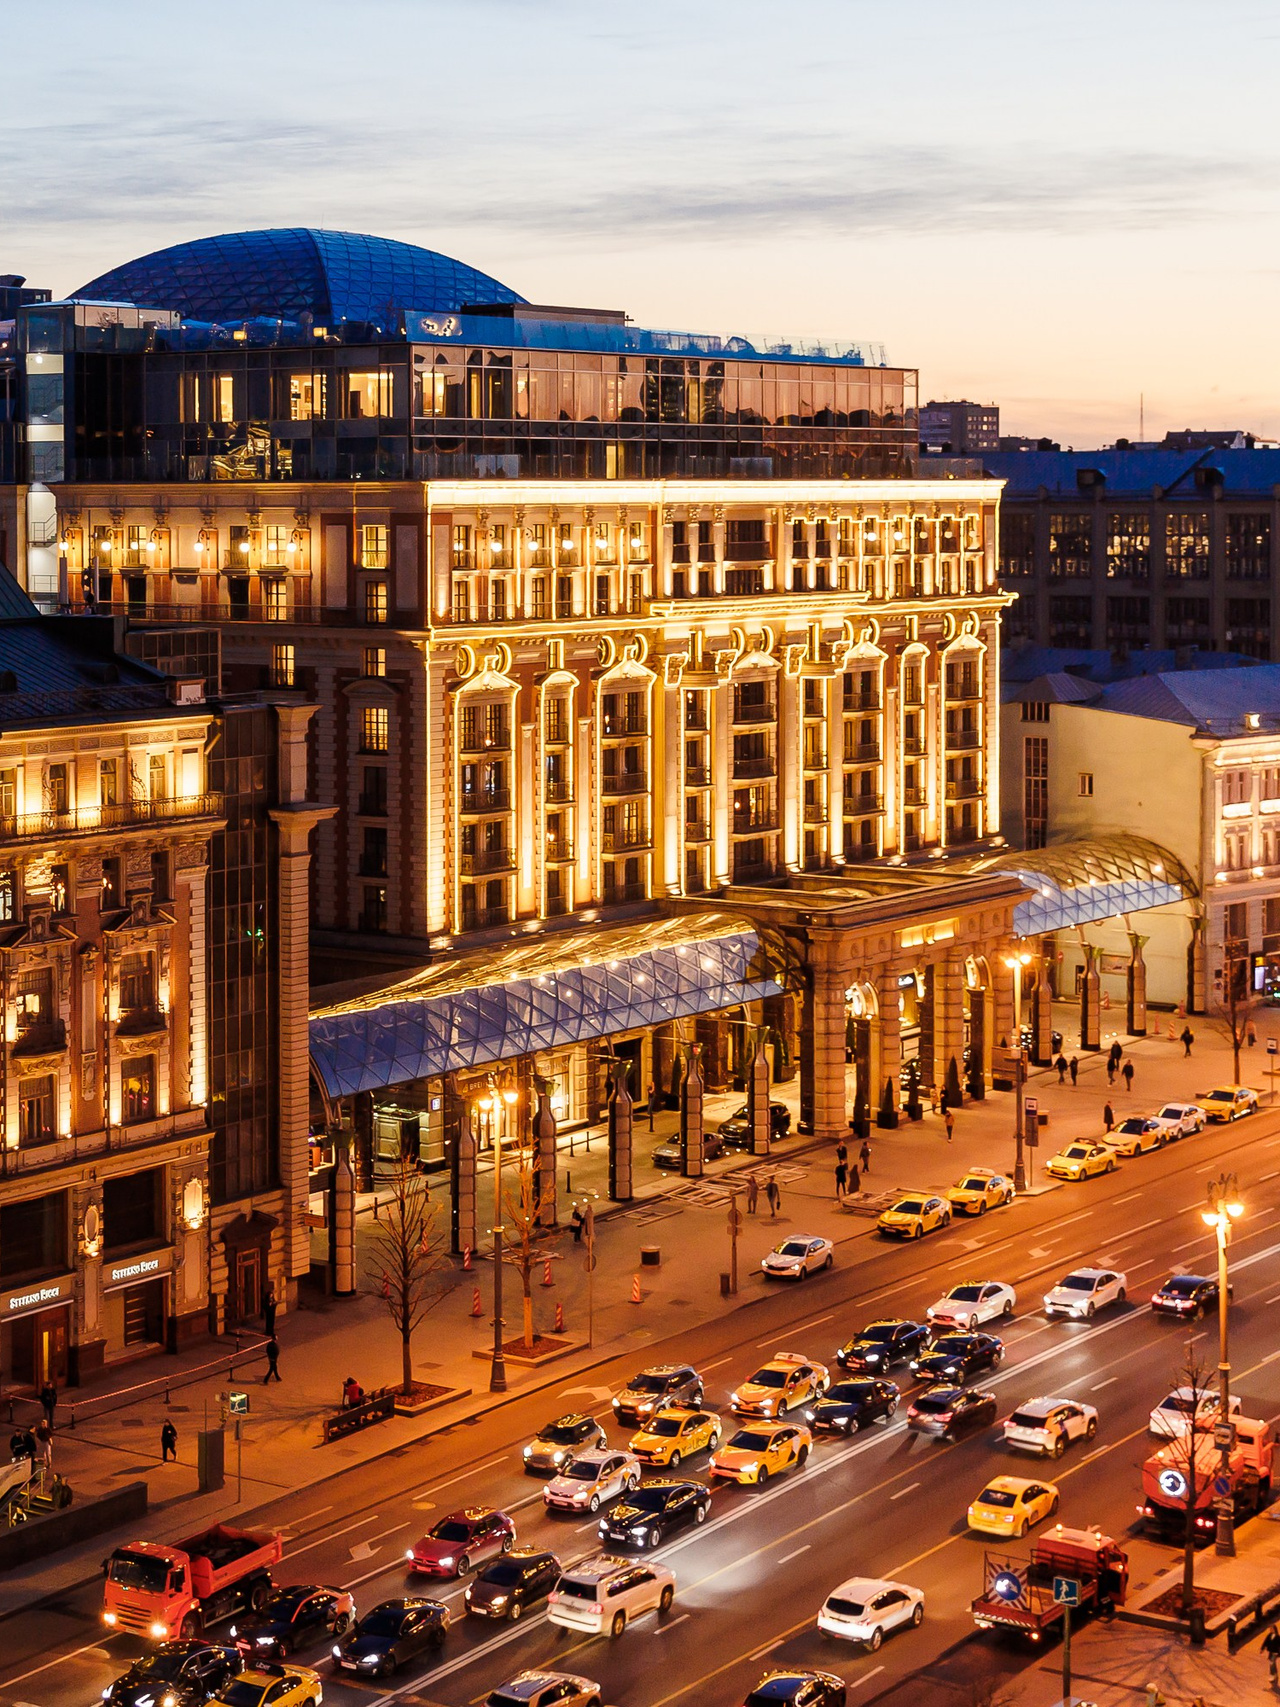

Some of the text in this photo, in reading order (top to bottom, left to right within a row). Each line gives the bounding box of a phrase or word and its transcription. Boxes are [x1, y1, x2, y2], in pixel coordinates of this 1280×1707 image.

[111, 1258, 159, 1281] STEFANO RICCI
[9, 1286, 60, 1310] STEFANO RICCI
[255, 1661, 271, 1671] Uber
